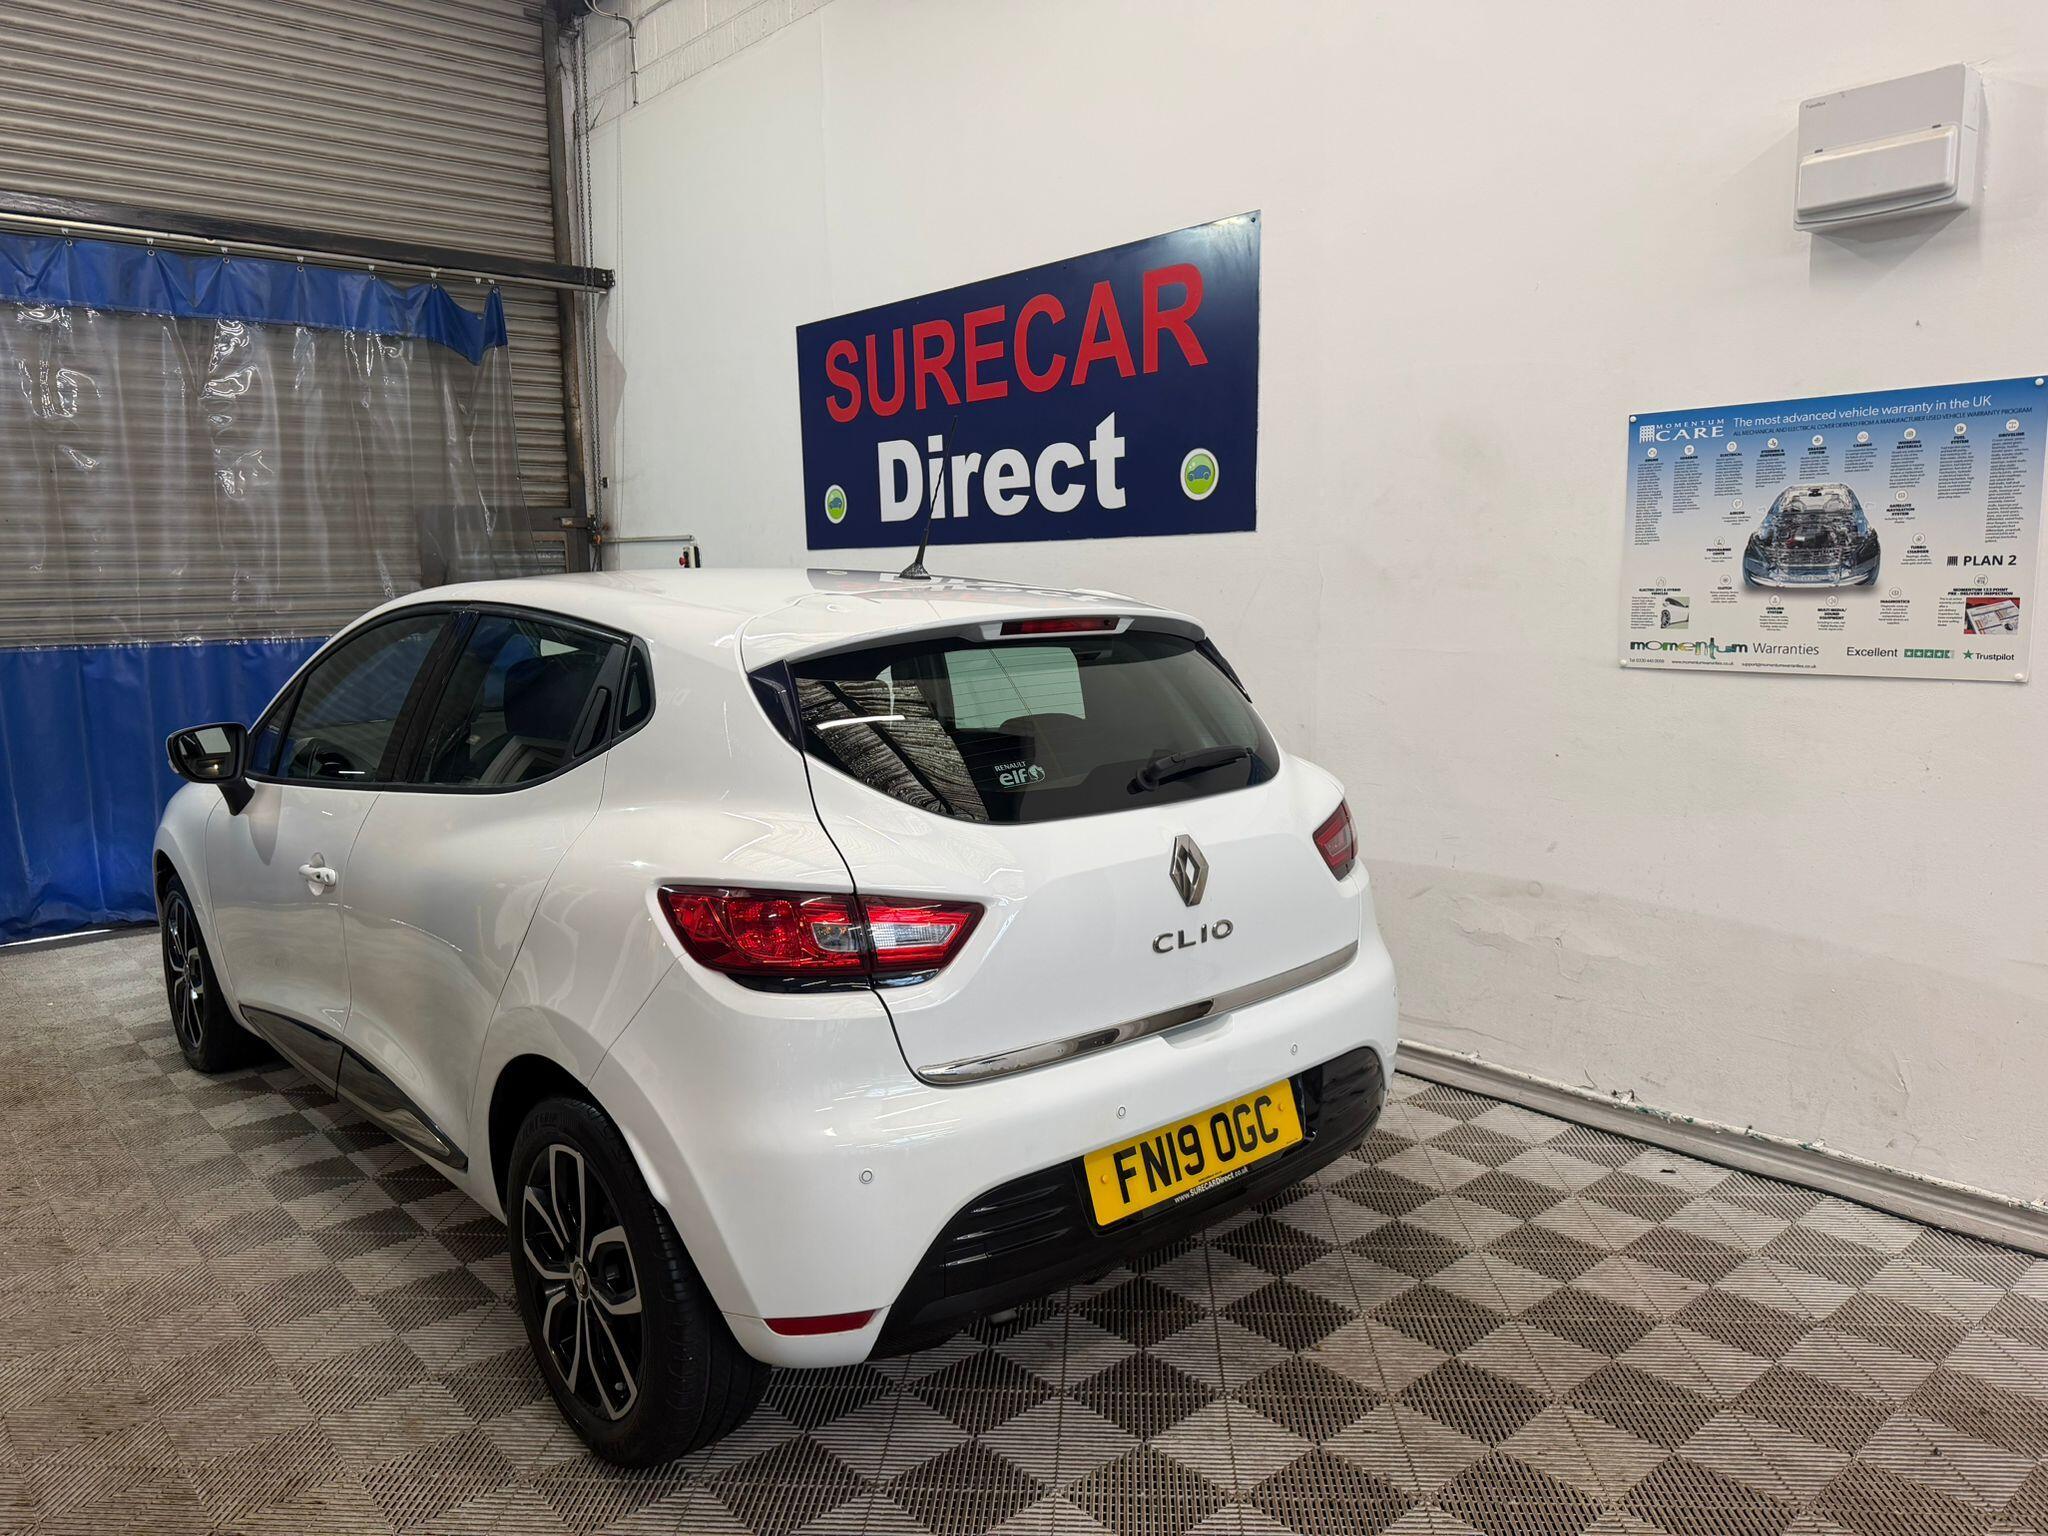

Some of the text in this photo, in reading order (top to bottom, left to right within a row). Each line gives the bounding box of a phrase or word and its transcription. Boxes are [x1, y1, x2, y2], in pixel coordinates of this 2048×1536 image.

[825, 262, 1209, 423] SURECAR
[1734, 395, 1992, 427] The most advanced vehicle warranty in the UK
[1742, 428, 1774, 436] MECHANICAL
[1787, 424, 1816, 432] ELECTRICAL
[1880, 415, 1925, 424] MANUFACTURER
[1942, 412, 1966, 420] VEHICLE
[1966, 409, 2001, 418] WARRANTY
[2001, 406, 2033, 415] PROGRAM
[1655, 426, 1724, 442] CARE
[1656, 418, 1724, 429] MOMENTUM
[877, 411, 1127, 523] Direct
[1963, 554, 2017, 566] PLAN 2
[1630, 637, 1820, 660] momentum Warranties
[1846, 646, 1898, 657] Excellent
[1975, 652, 2015, 661] Trustpilot
[994, 761, 1026, 772] RENAULT
[1000, 768, 1027, 786] elf
[1152, 919, 1233, 953] CLIO
[1113, 1095, 1279, 1204] FN19 OGC
[1173, 1166, 1250, 1204] www.SURECARDirect.co.uk
